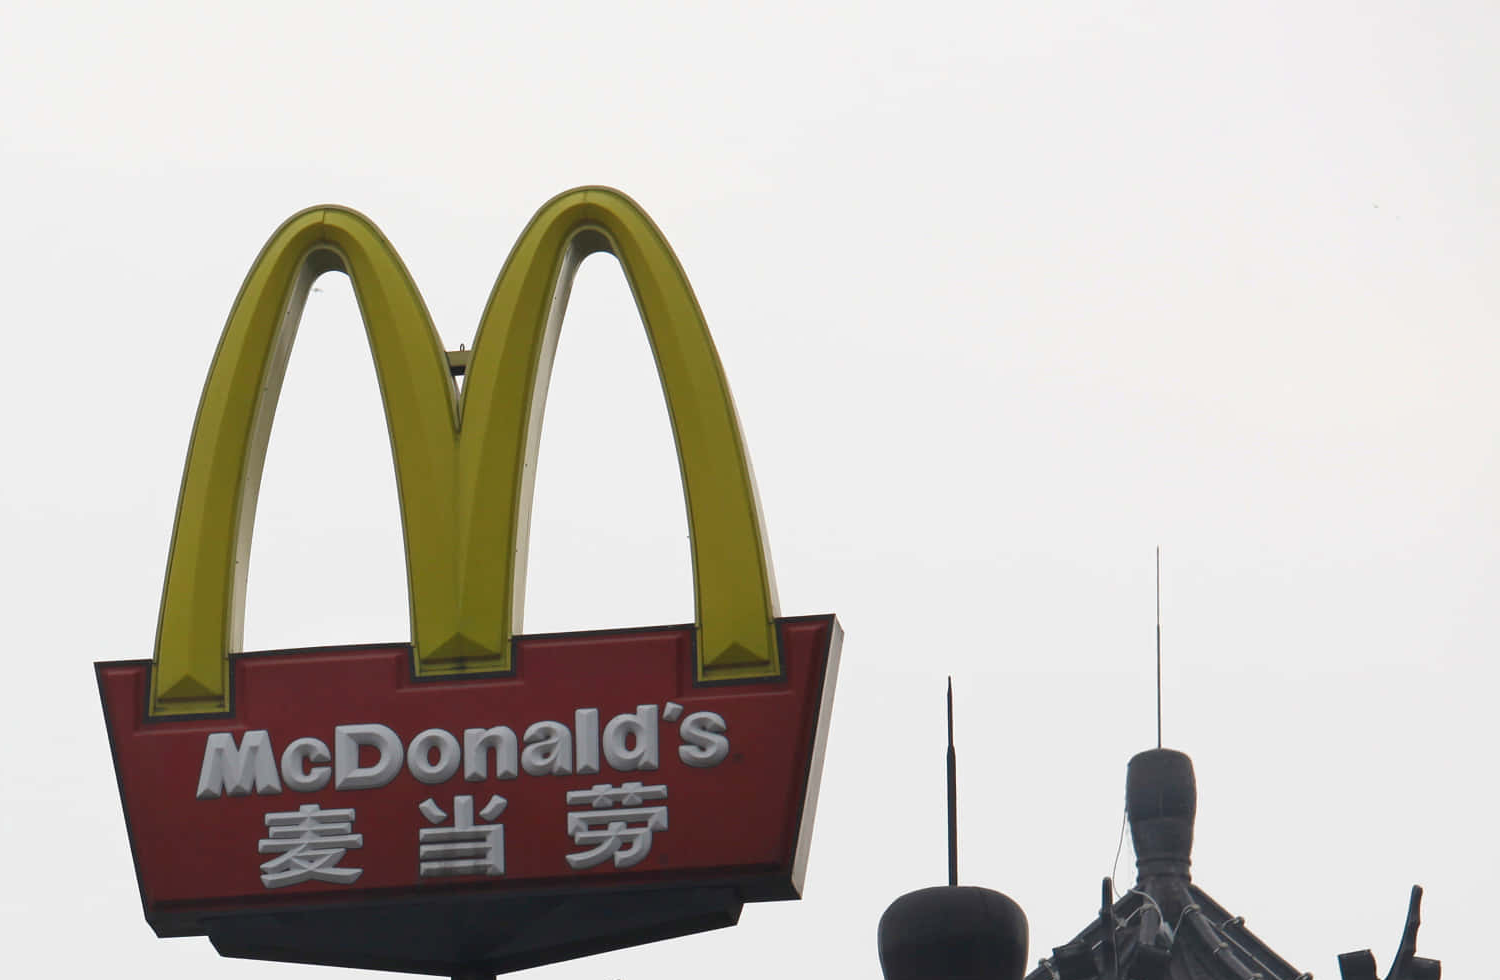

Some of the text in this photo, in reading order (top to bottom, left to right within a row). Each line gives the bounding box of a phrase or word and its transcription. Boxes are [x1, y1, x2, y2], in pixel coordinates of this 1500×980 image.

[196, 702, 729, 798] McDonald's
[258, 782, 669, 889] 麦当劳
